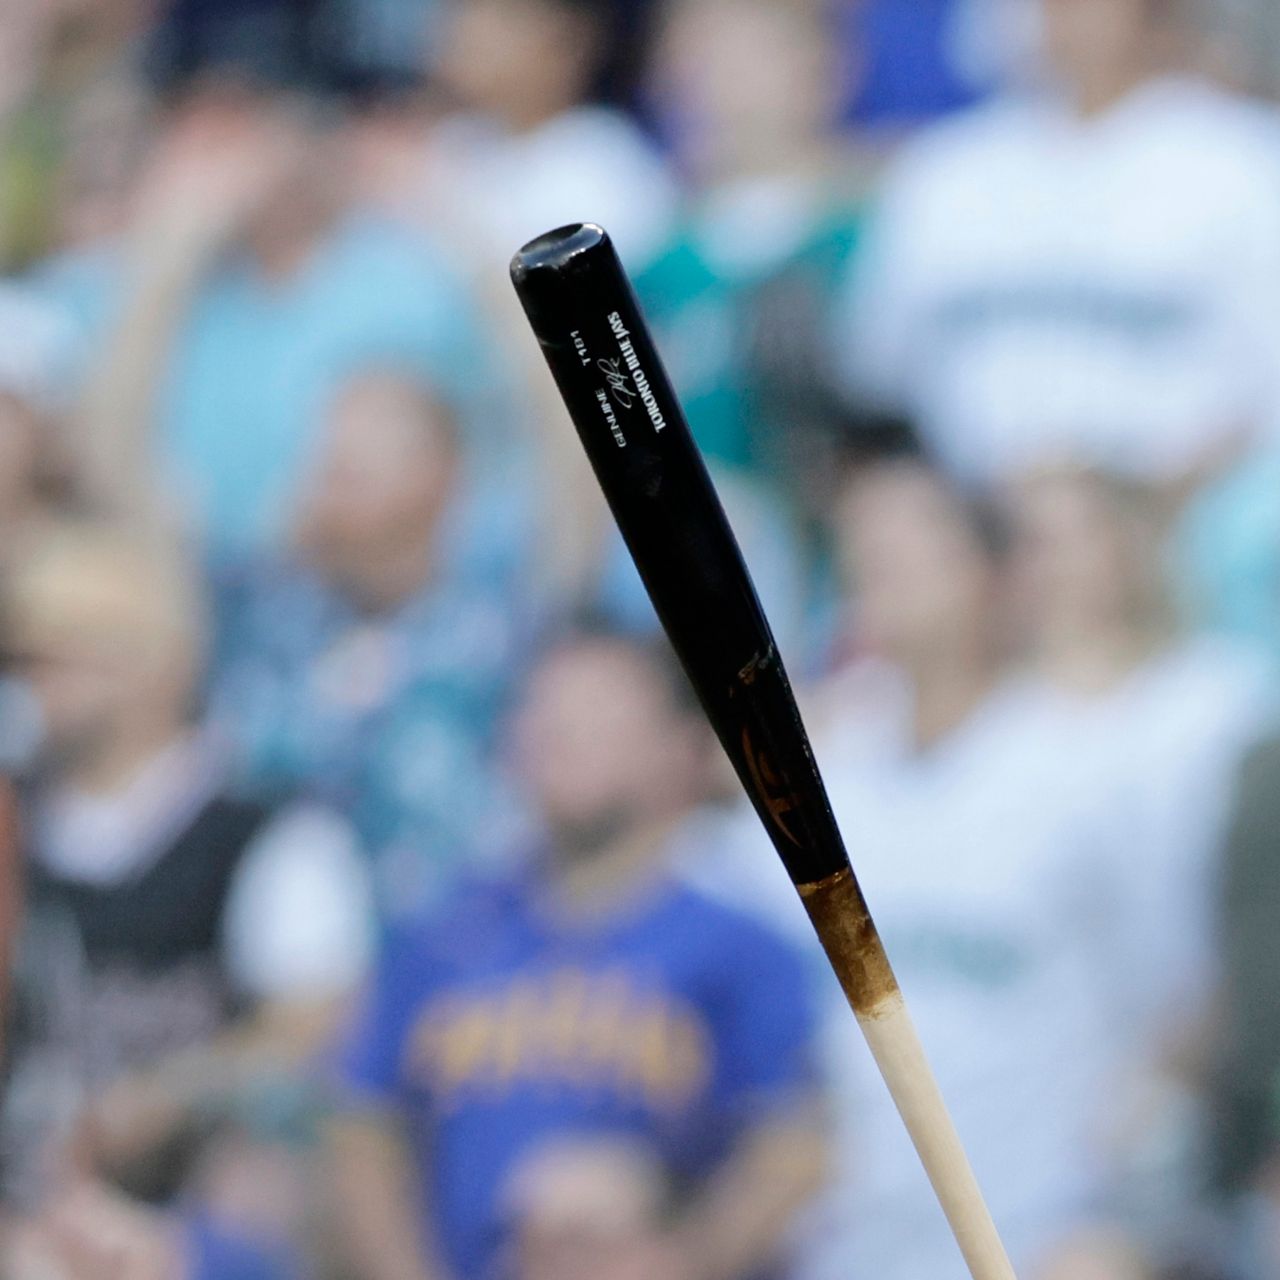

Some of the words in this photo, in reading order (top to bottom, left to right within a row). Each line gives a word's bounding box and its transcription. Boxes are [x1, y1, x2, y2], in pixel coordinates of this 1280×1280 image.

[607, 311, 631, 340] JAYS
[618, 336, 641, 371] BLUE
[595, 388, 627, 448] GENUINE
[632, 369, 666, 433] TORONTO
